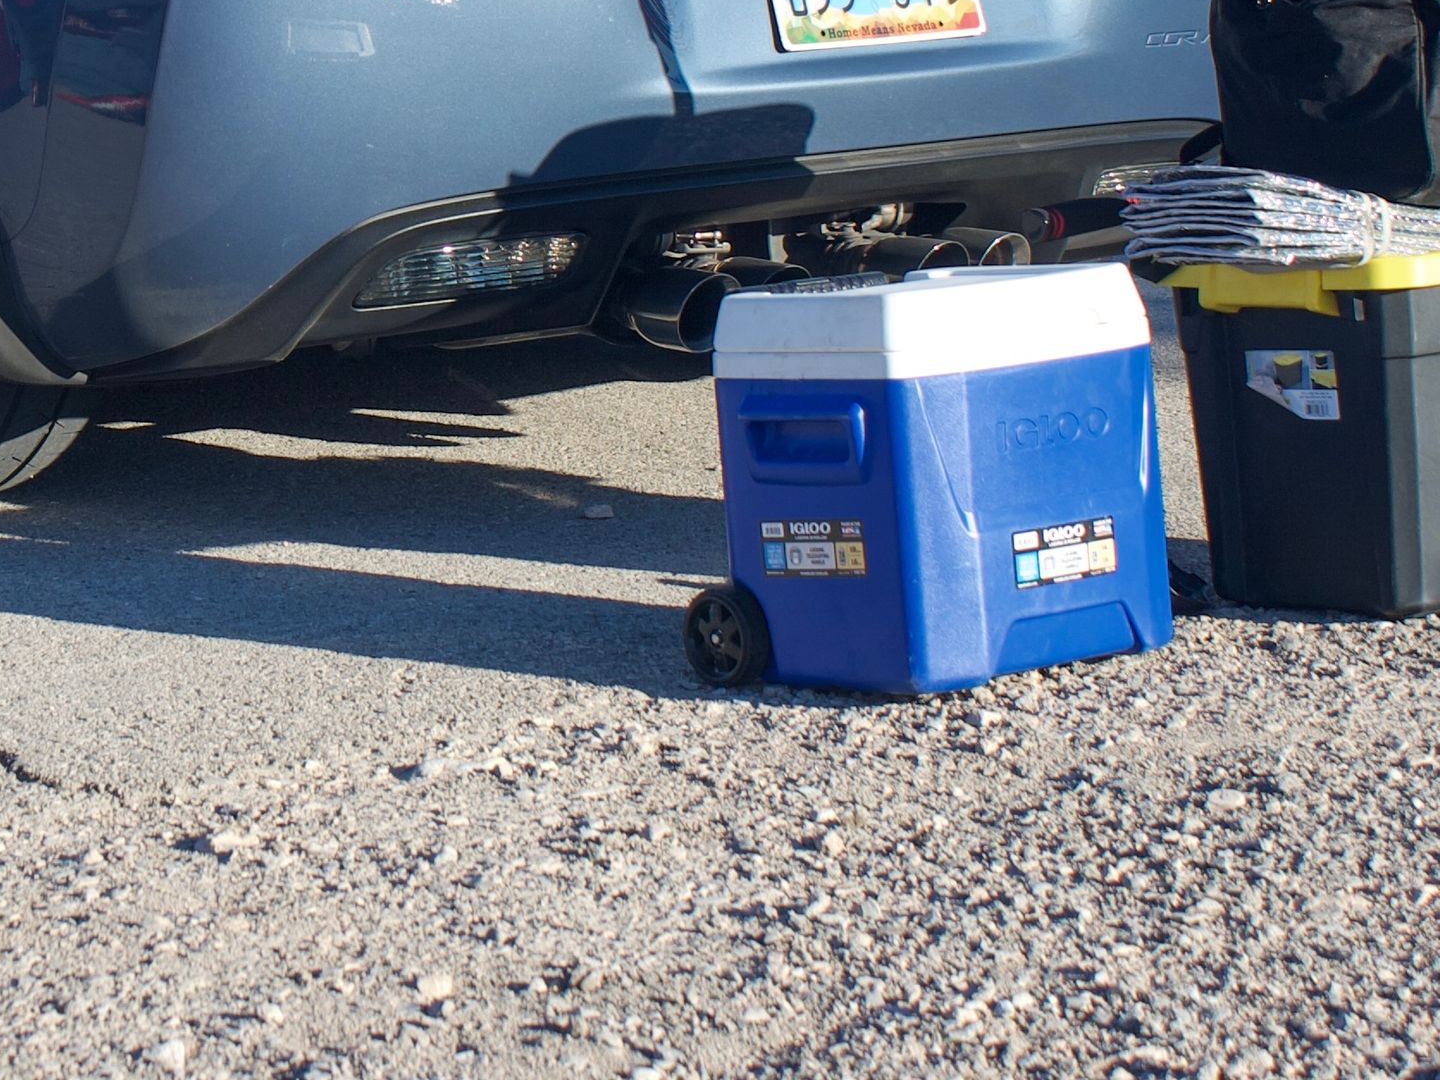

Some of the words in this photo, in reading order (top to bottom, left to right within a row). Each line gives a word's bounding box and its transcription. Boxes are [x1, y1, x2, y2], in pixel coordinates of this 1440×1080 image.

[828, 28, 859, 39] Home
[863, 26, 896, 37] Means
[898, 22, 937, 34] Nevada
[996, 406, 1110, 454] IGLOO
[789, 522, 831, 535] IGLOO
[1043, 524, 1086, 542] IGLOO
